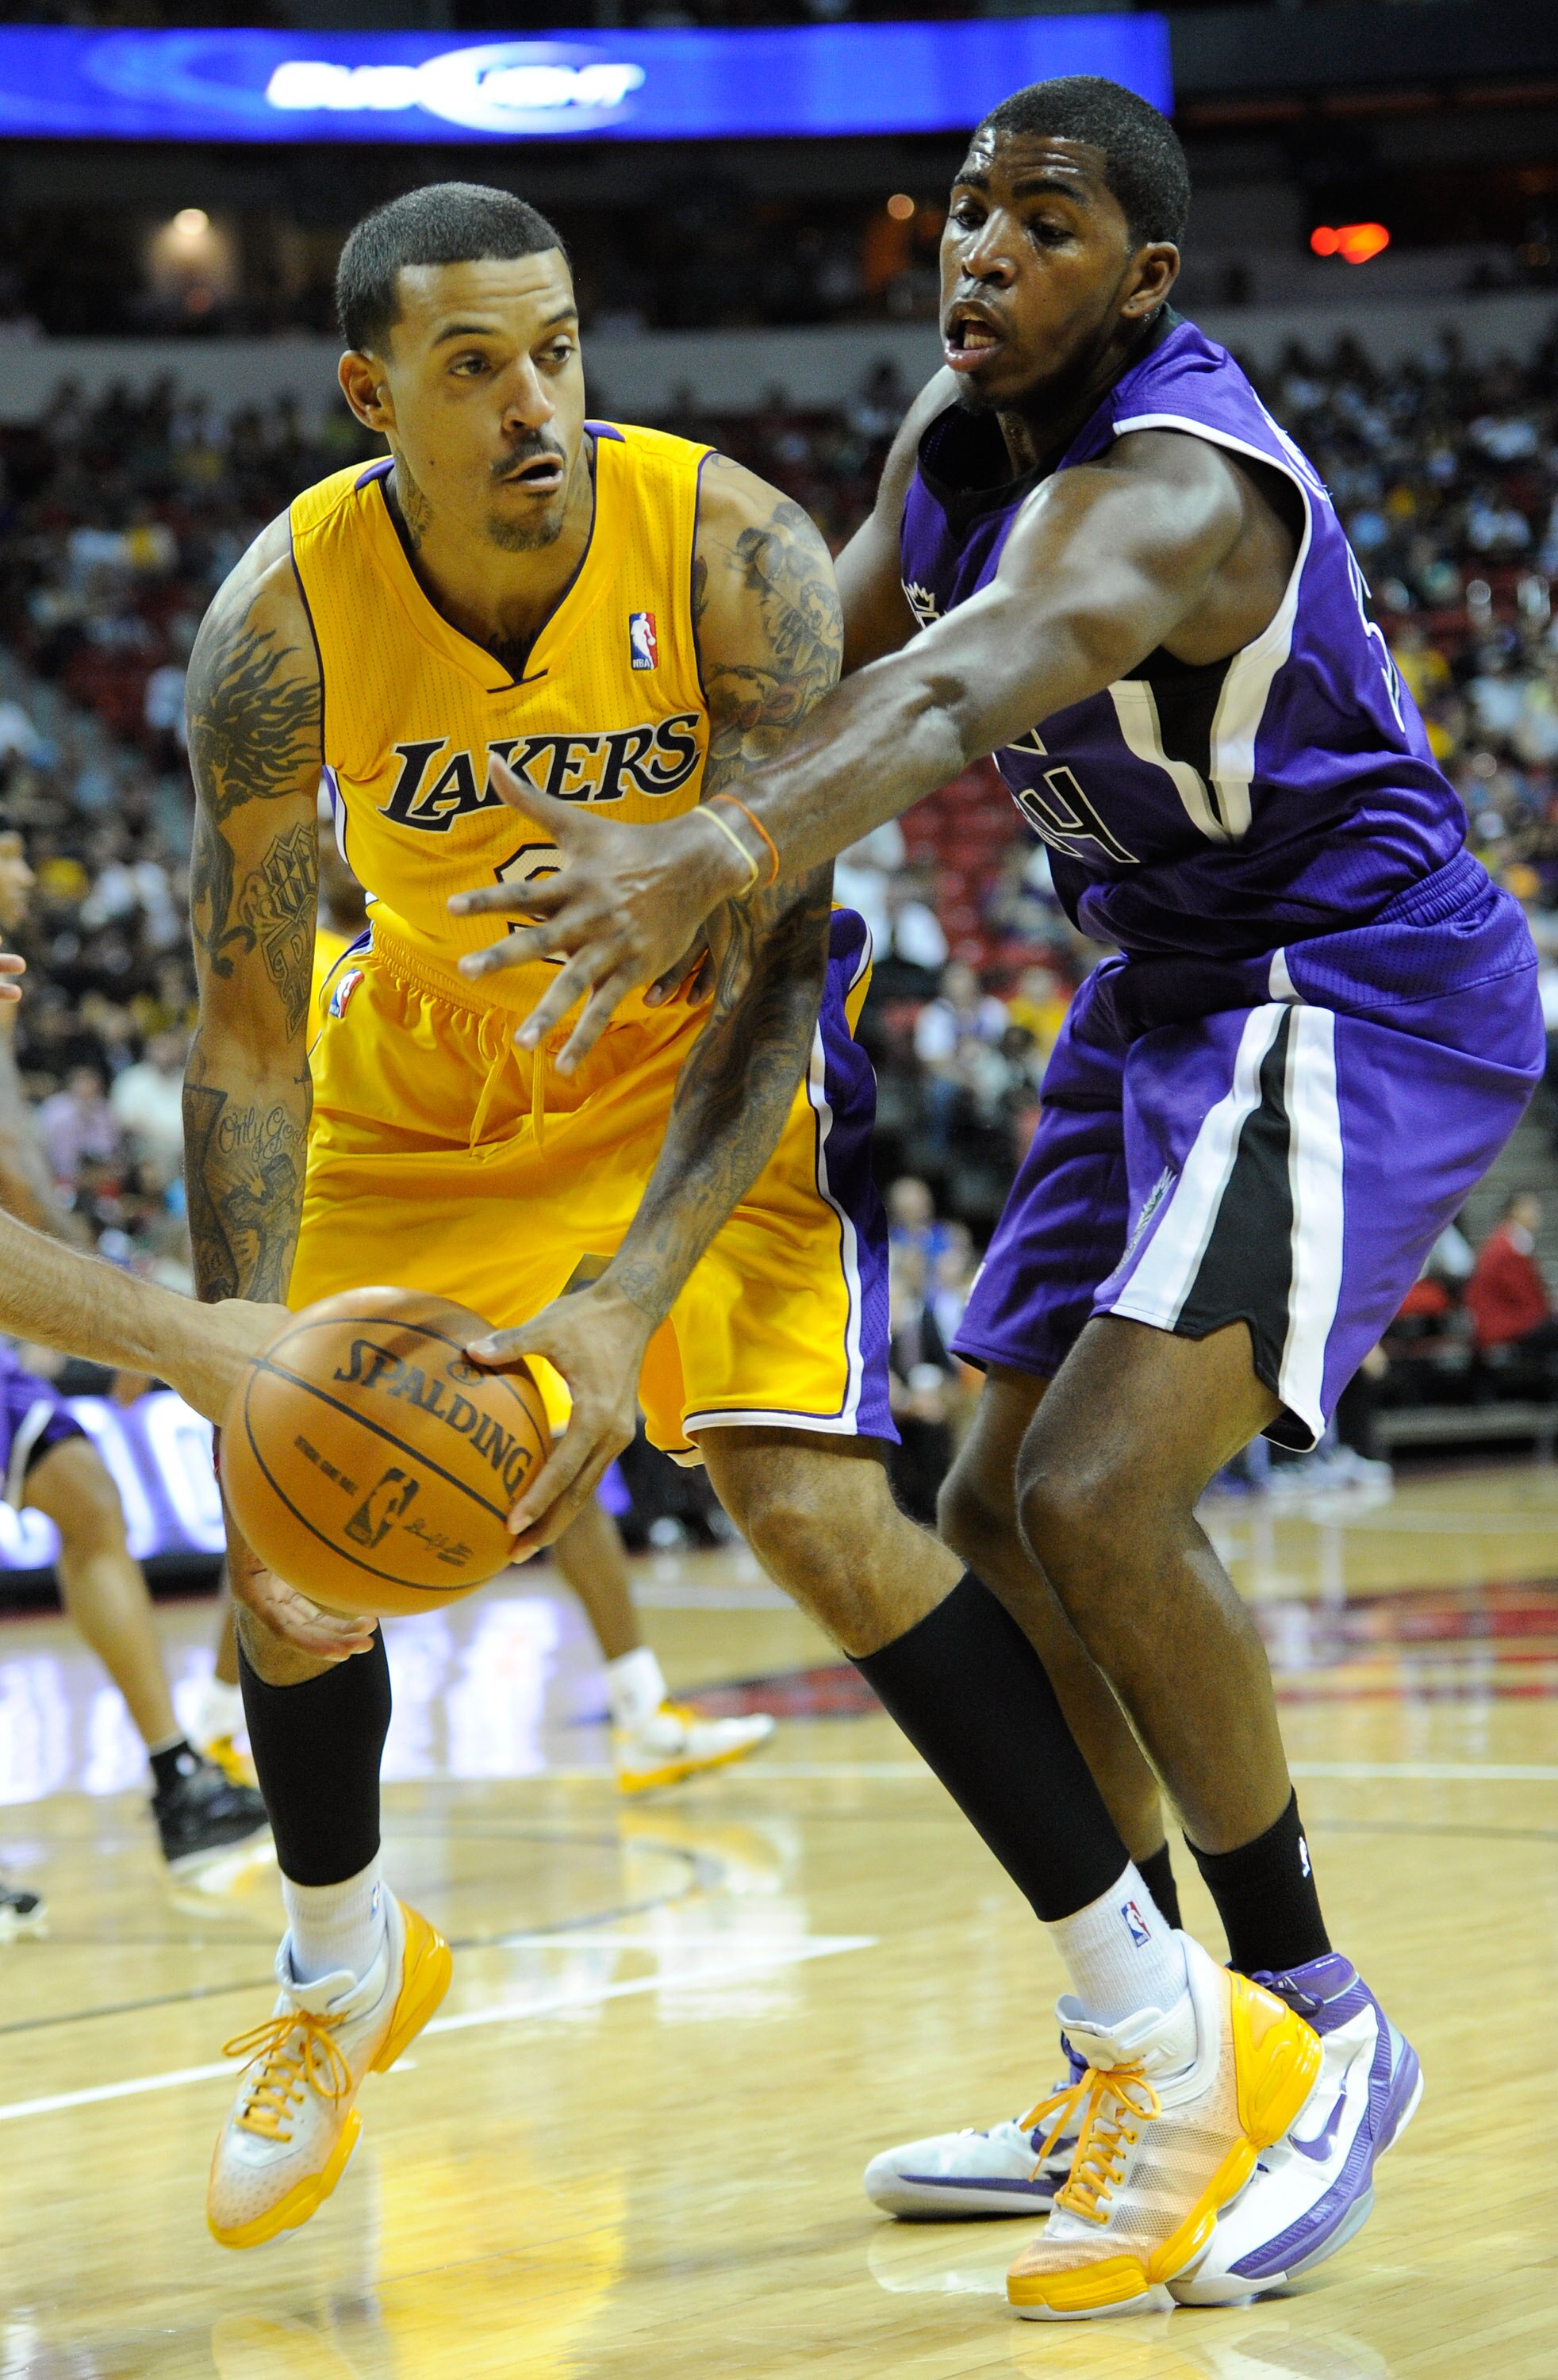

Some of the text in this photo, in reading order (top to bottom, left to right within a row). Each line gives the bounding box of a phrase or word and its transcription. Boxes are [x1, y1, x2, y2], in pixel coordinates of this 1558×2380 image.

[632, 658, 650, 669] NBA
[377, 712, 701, 833] LAKERS
[219, 1106, 264, 1162] Only
[333, 1339, 534, 1498] SPALDING
